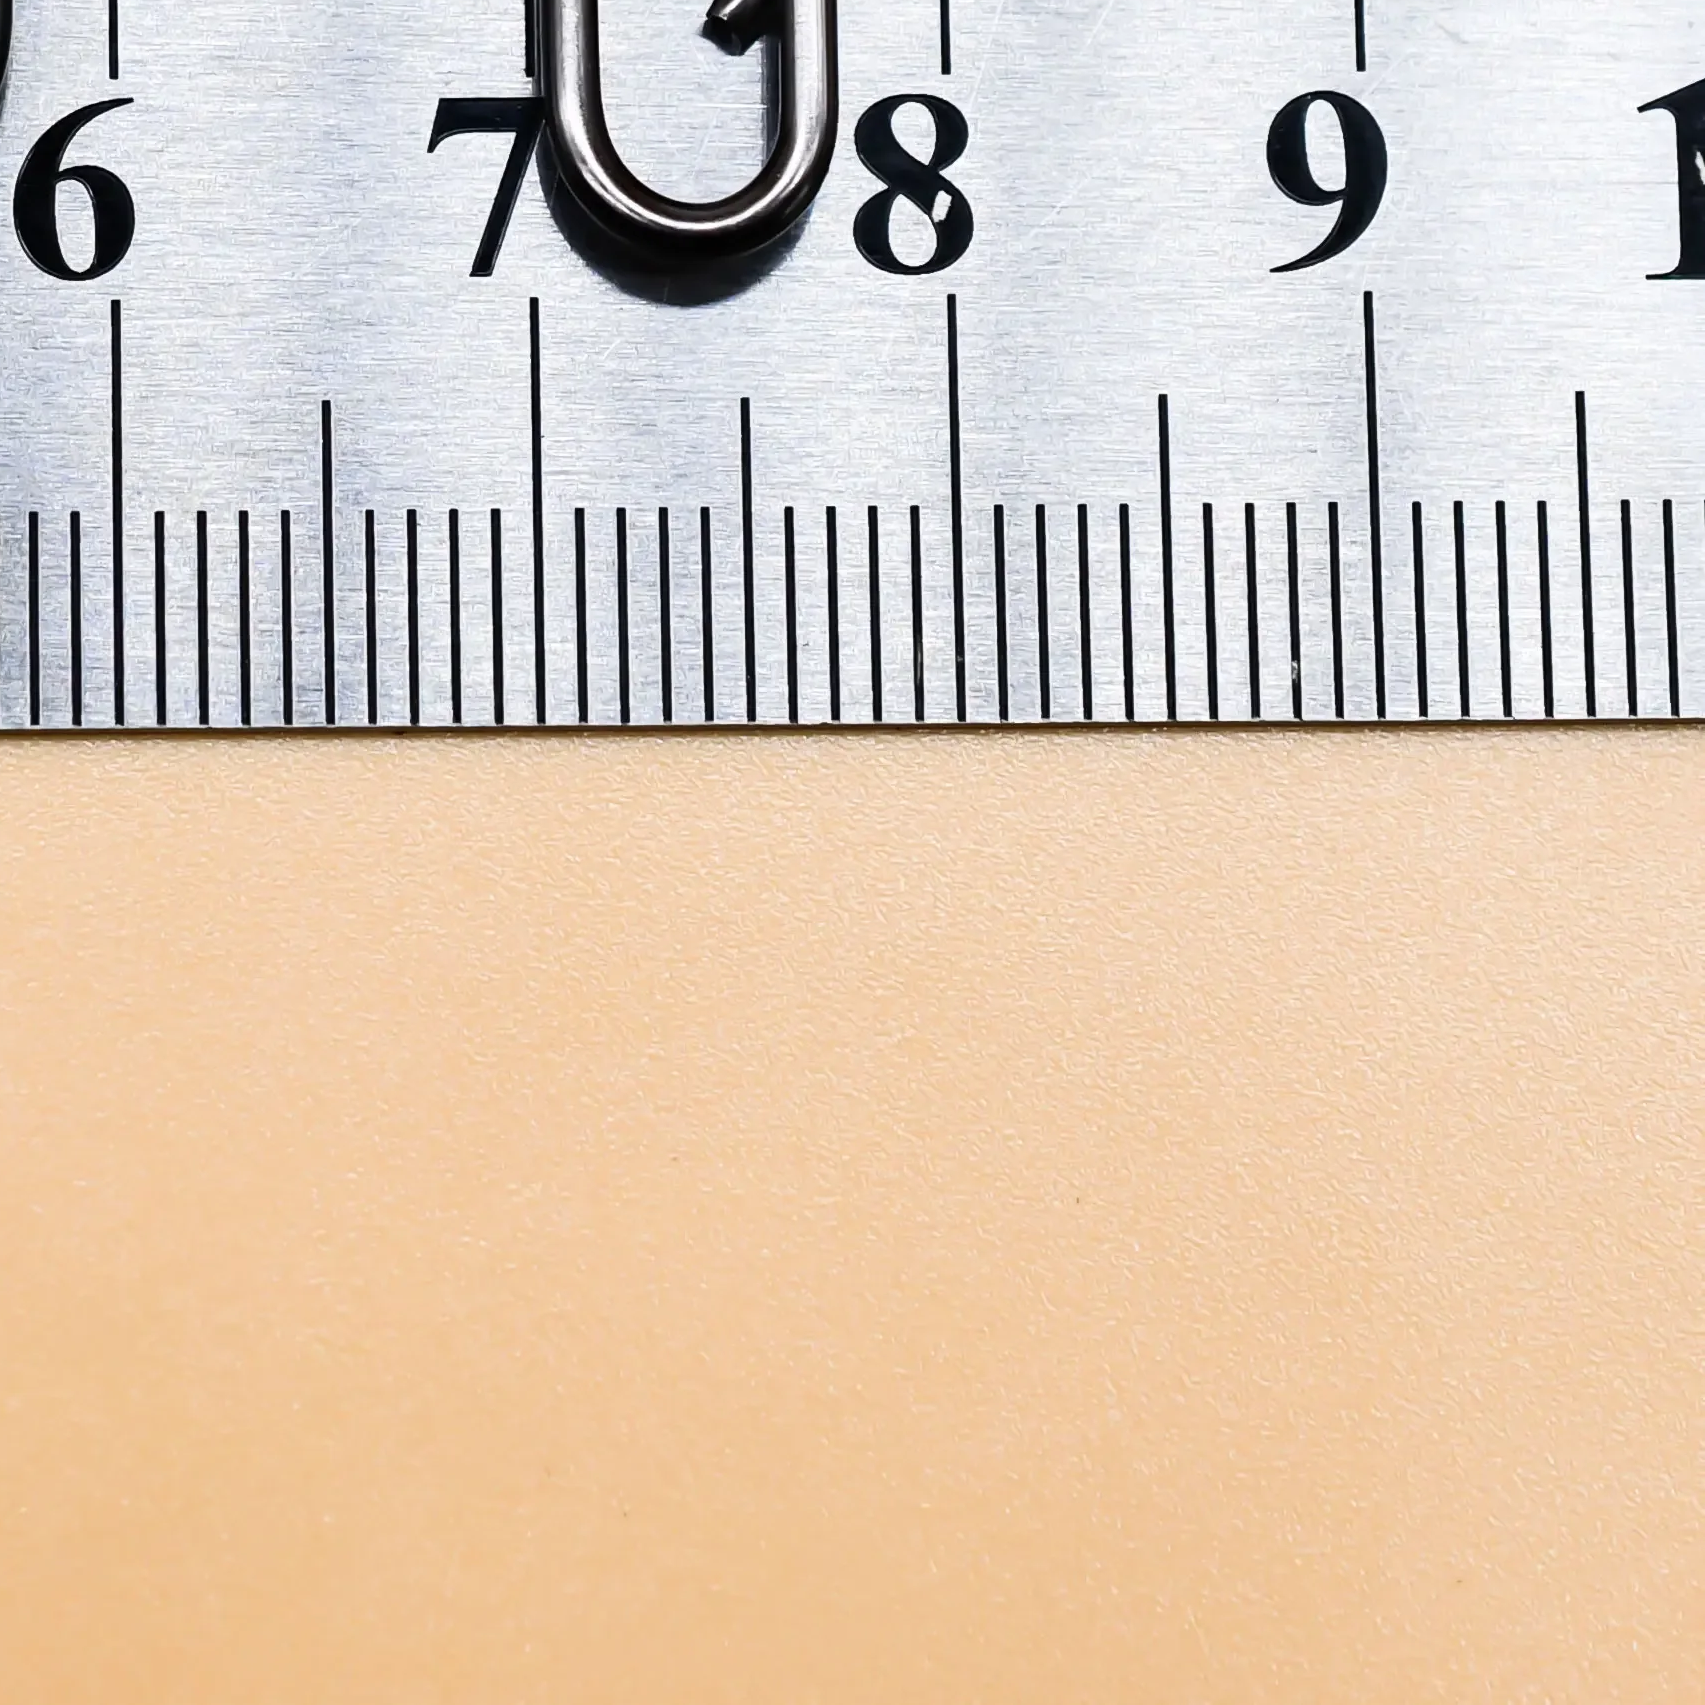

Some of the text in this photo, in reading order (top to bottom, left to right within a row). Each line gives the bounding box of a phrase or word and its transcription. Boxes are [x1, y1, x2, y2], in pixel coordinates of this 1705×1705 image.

[13, 98, 135, 281] 6
[427, 96, 546, 277] 7
[853, 94, 973, 275] 8
[1267, 91, 1387, 272] 9
